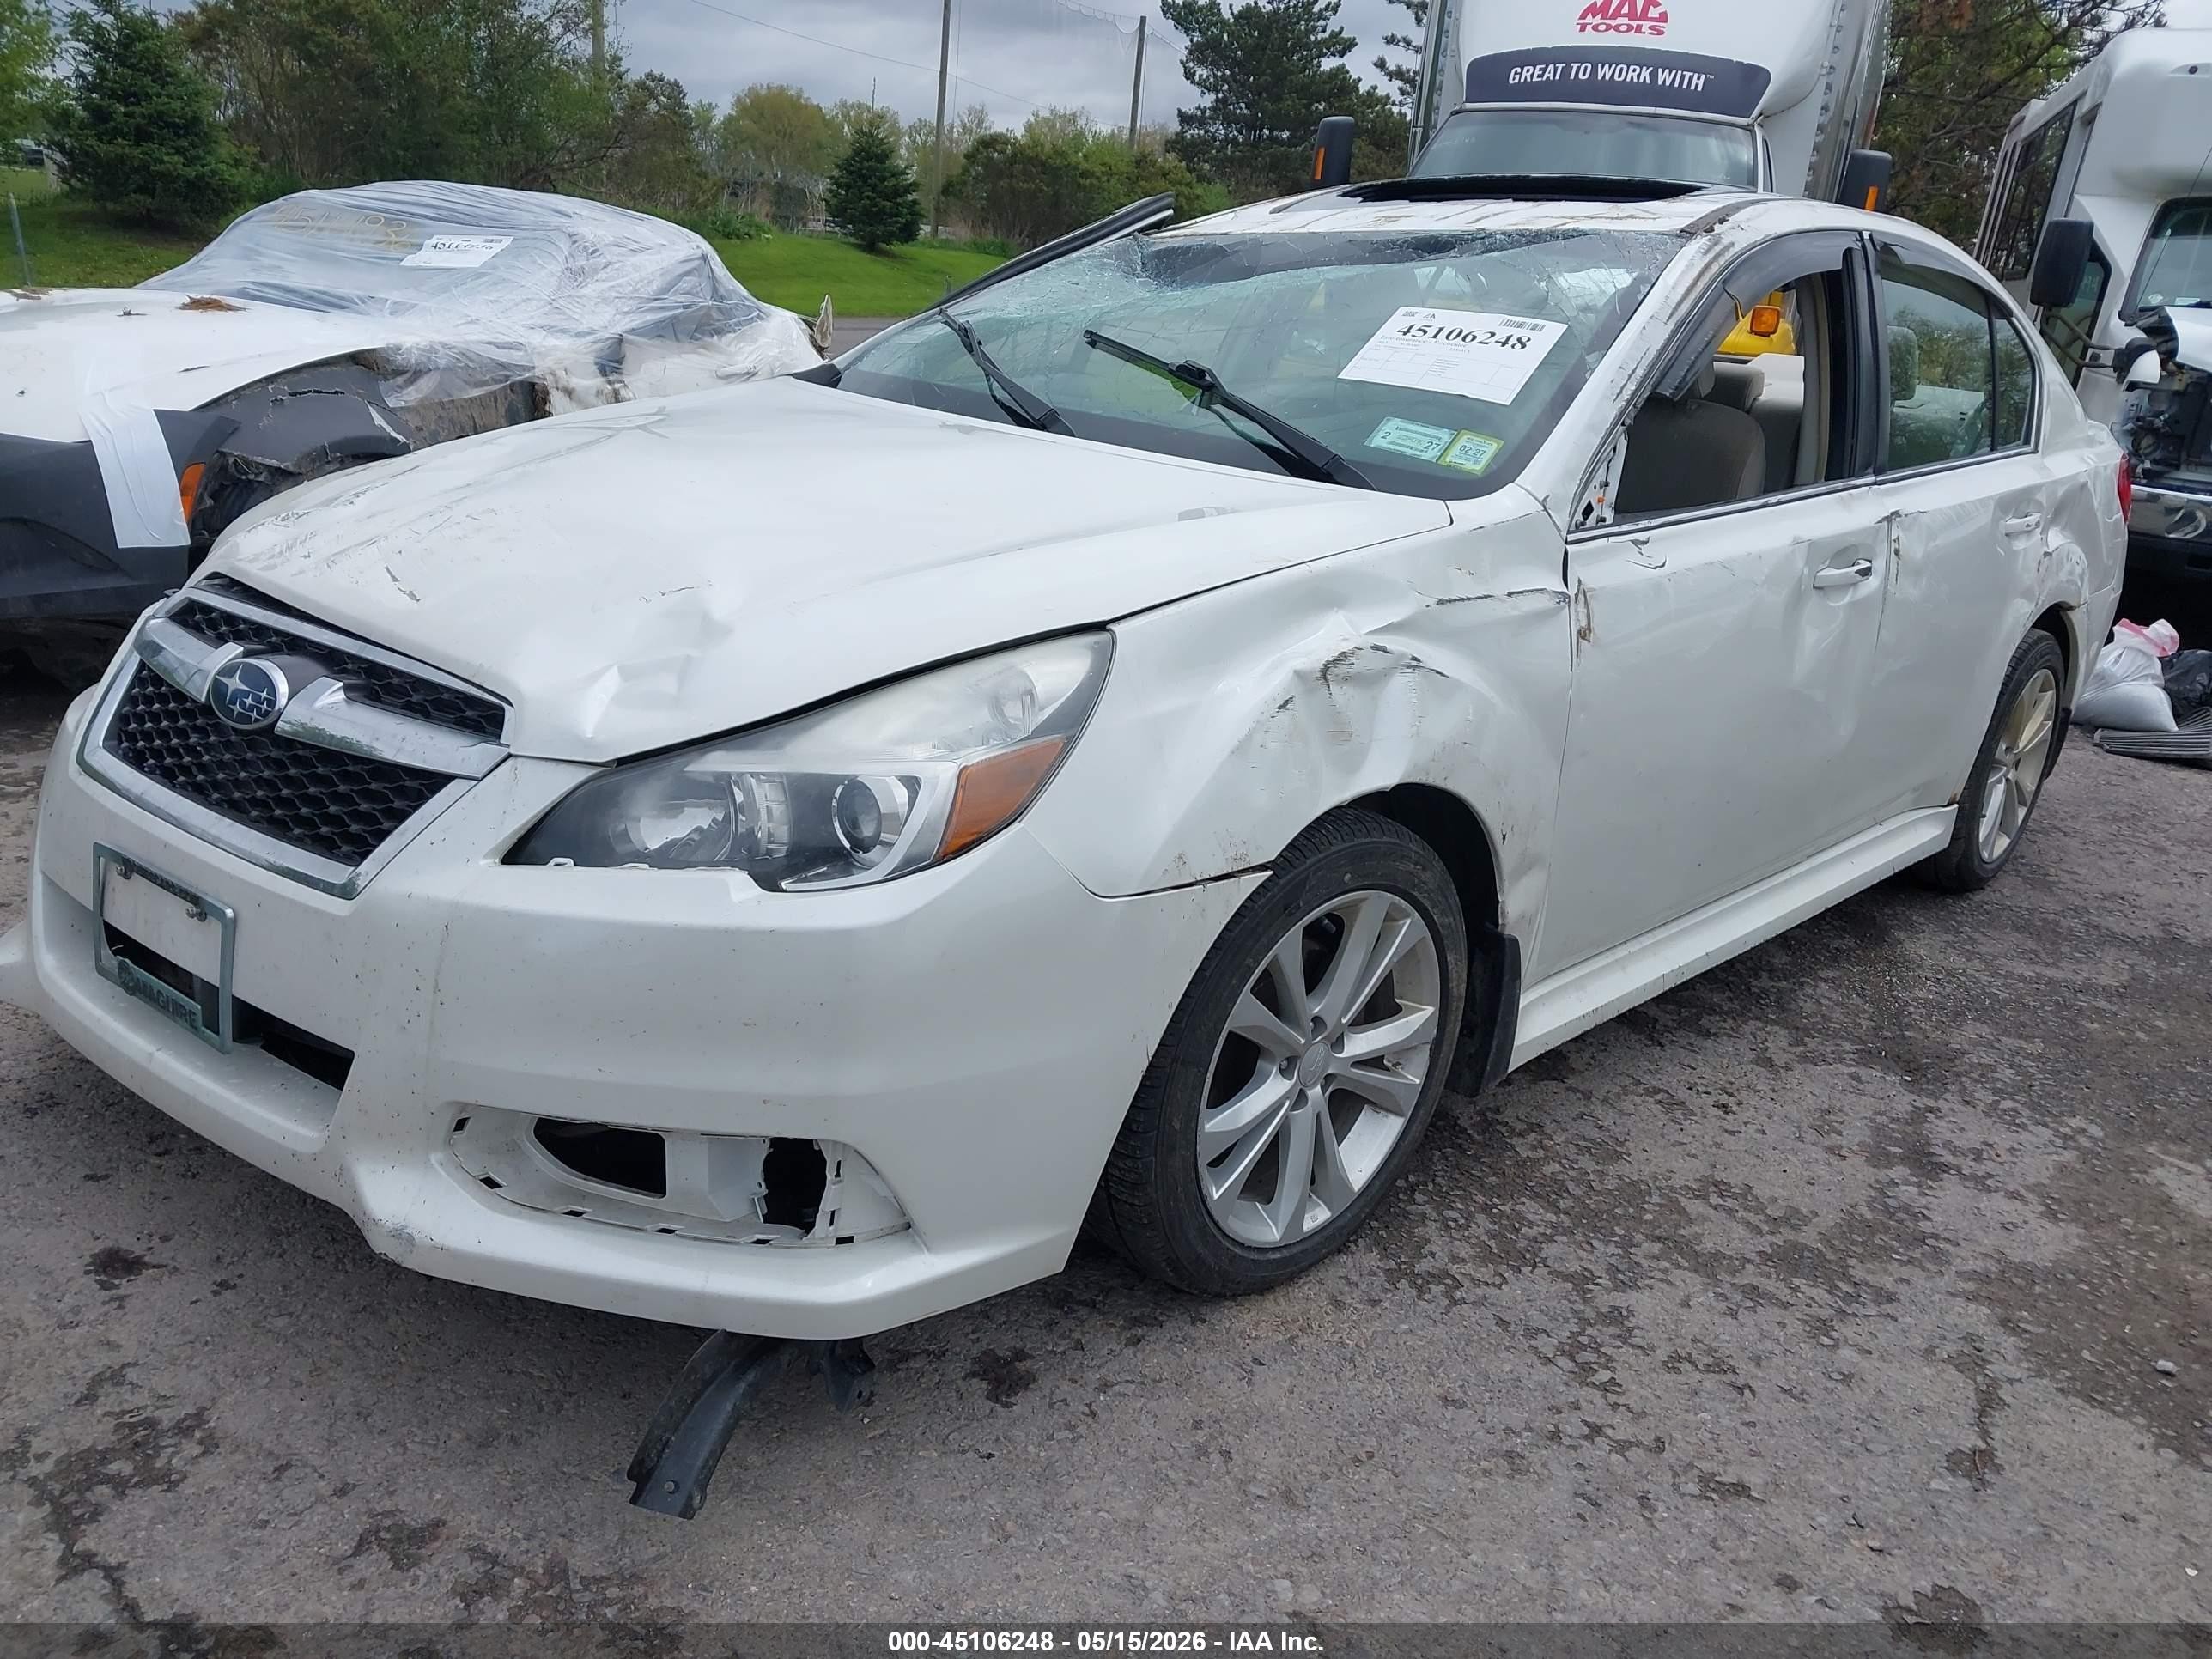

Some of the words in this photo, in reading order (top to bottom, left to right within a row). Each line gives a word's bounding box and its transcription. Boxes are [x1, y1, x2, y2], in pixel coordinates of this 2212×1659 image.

[1578, 0, 1668, 23] MAC
[1577, 21, 1666, 36] TOOLS
[1509, 64, 1566, 85] GREAT
[1570, 63, 1593, 80] TO
[1597, 64, 1653, 85] WORK
[1396, 323, 1532, 351] 45106248
[1380, 430, 1390, 441] 2
[1424, 441, 1440, 451] 27
